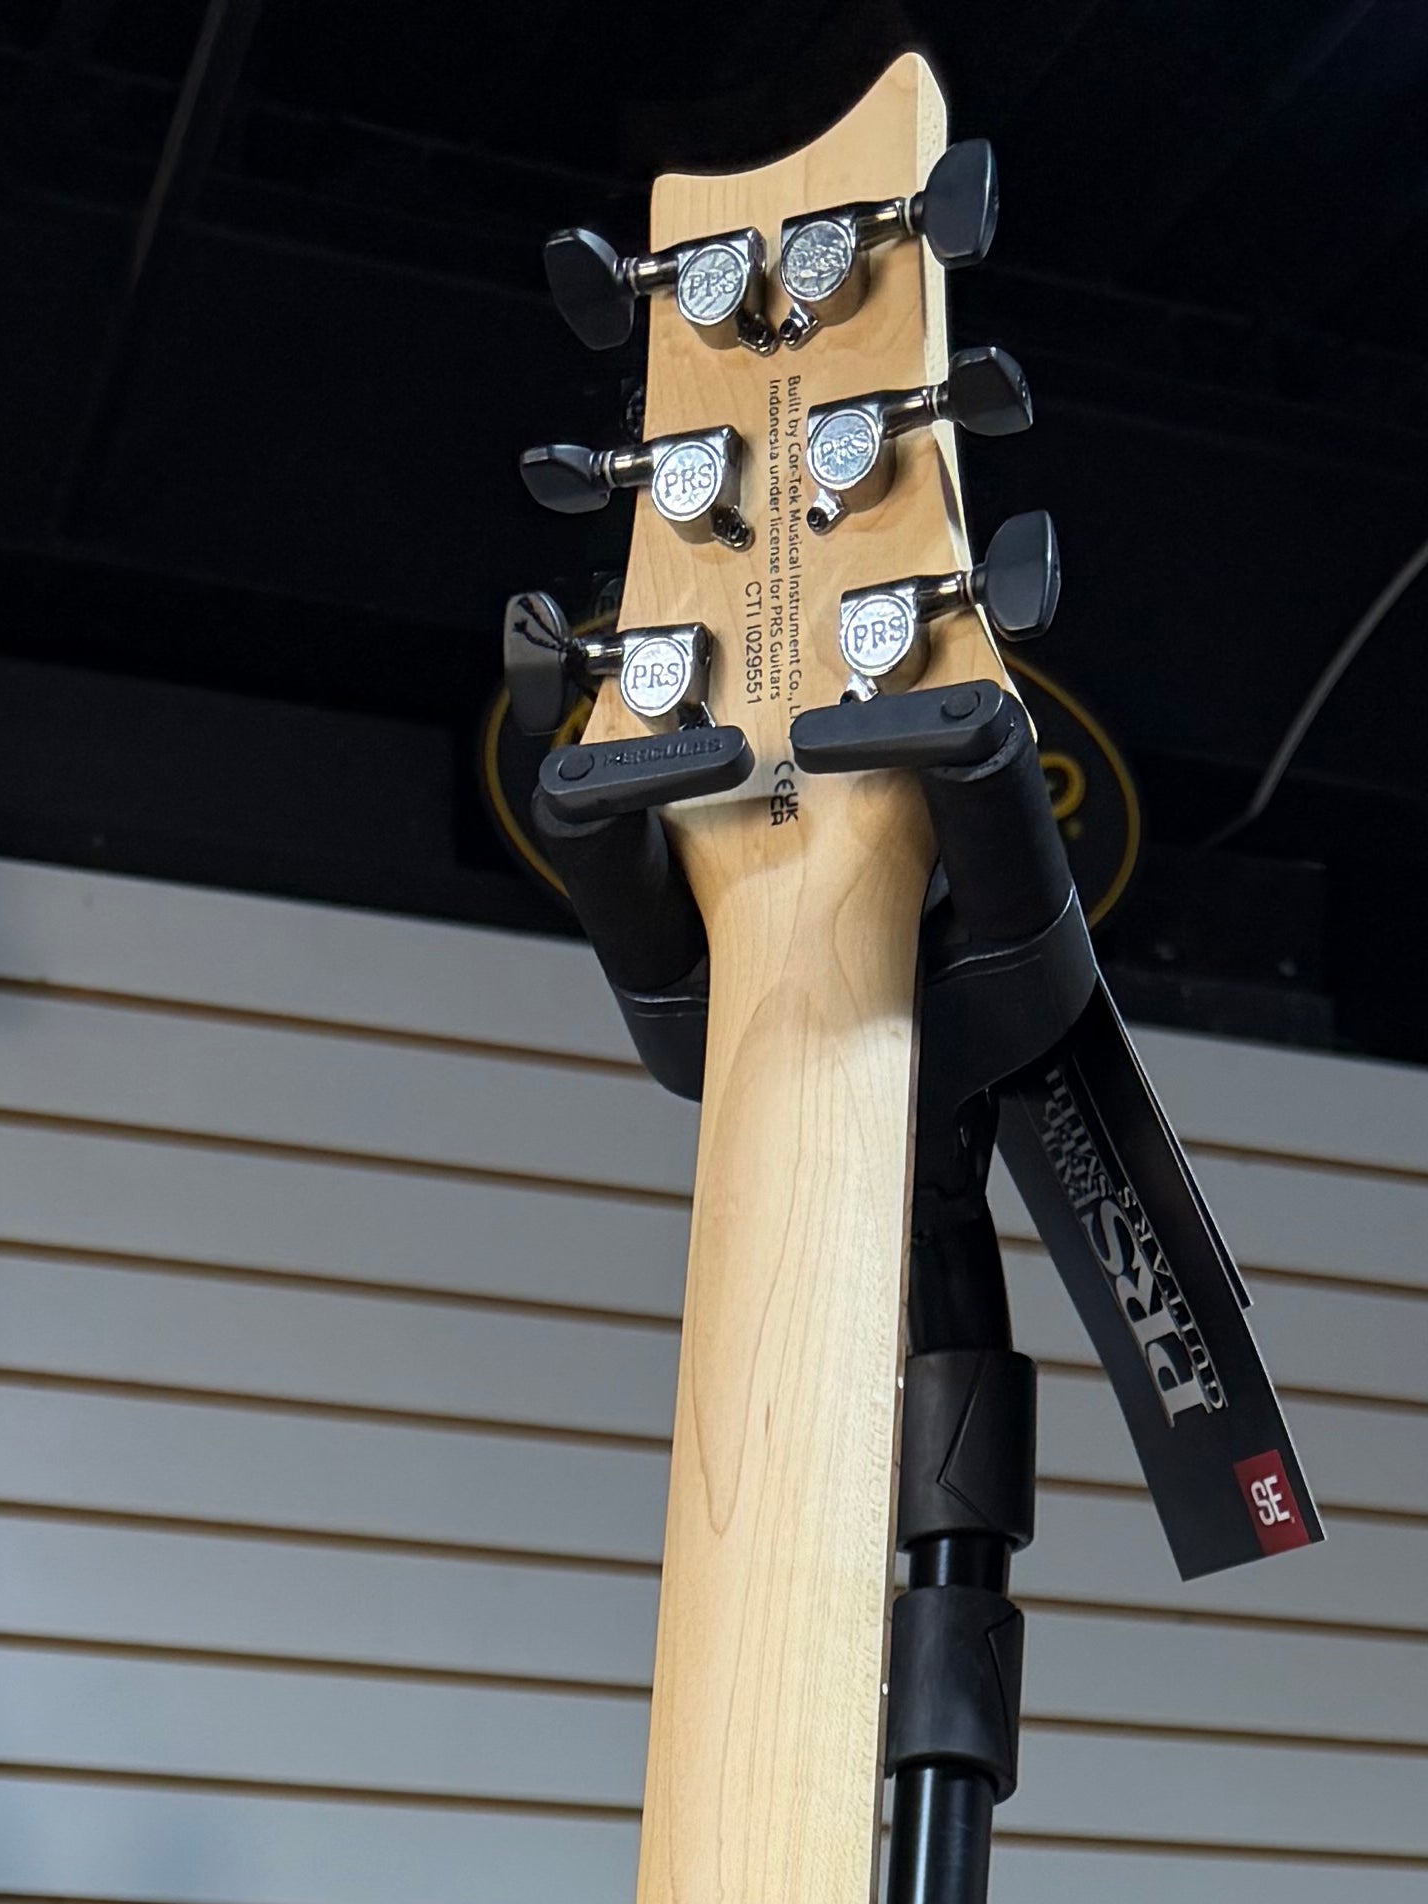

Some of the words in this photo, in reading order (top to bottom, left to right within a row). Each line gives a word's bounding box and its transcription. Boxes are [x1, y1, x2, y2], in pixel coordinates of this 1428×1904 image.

[769, 379, 782, 461] Indonesia
[787, 375, 802, 412] Built
[785, 418, 801, 438] by
[662, 460, 713, 499] PRS
[769, 464, 783, 513] under
[787, 442, 803, 504] Cor-Tek
[769, 518, 783, 574] license
[788, 508, 803, 570] Musical
[770, 577, 784, 600] for
[770, 605, 783, 638] PRS
[788, 574, 803, 666] Instrument
[852, 614, 909, 654] PRS
[630, 661, 681, 690] PRS
[770, 641, 784, 700] Guitars
[1081, 1200, 1213, 1428] PRS
[1116, 1184, 1228, 1411] GUITARS
[1250, 1474, 1291, 1528] SE
